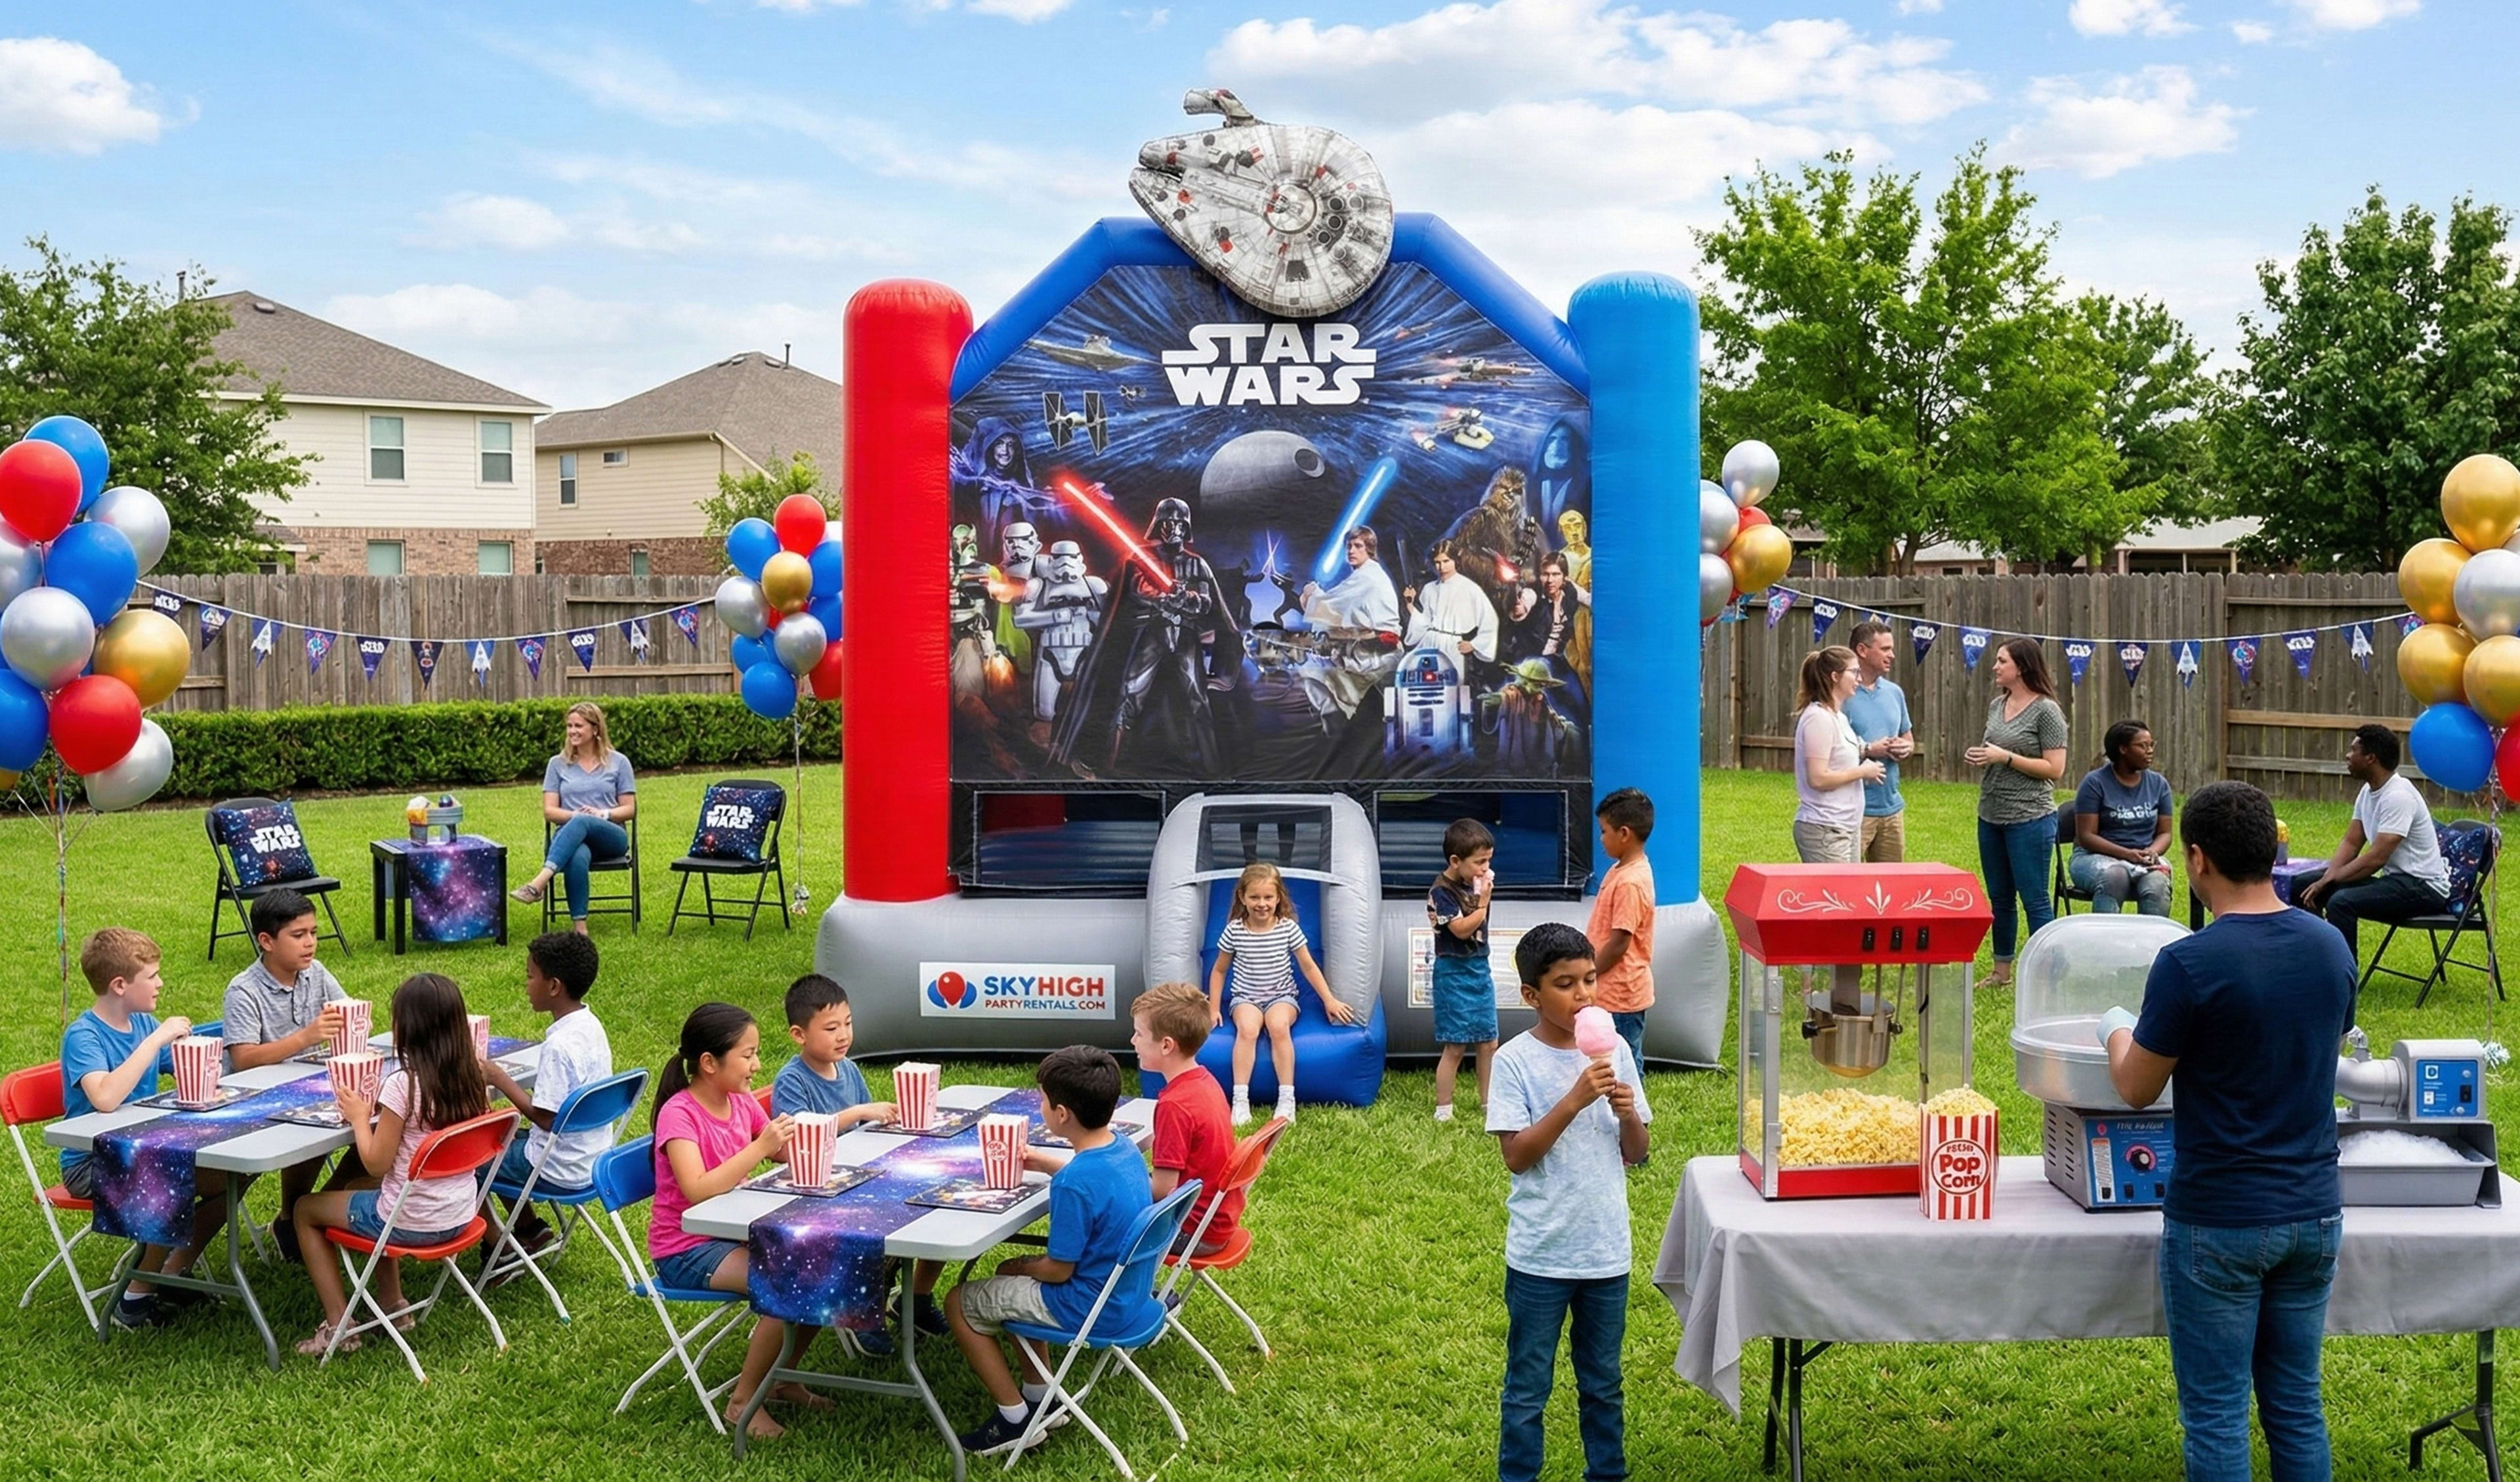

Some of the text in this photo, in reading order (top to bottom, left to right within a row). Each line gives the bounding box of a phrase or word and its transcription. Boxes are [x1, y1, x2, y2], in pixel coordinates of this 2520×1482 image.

[1162, 323, 1377, 364] STAR
[1164, 365, 1375, 406] WARS
[707, 805, 755, 818] STAR
[706, 815, 753, 829] WARS
[250, 823, 299, 841] STAR
[249, 834, 301, 854] WARS
[984, 976, 1104, 997] SKYHIGH
[985, 1000, 1105, 1009] PARTYRENTALS.COM
[1939, 1154, 1981, 1174] Pop
[1941, 1174, 1980, 1188] Corn
